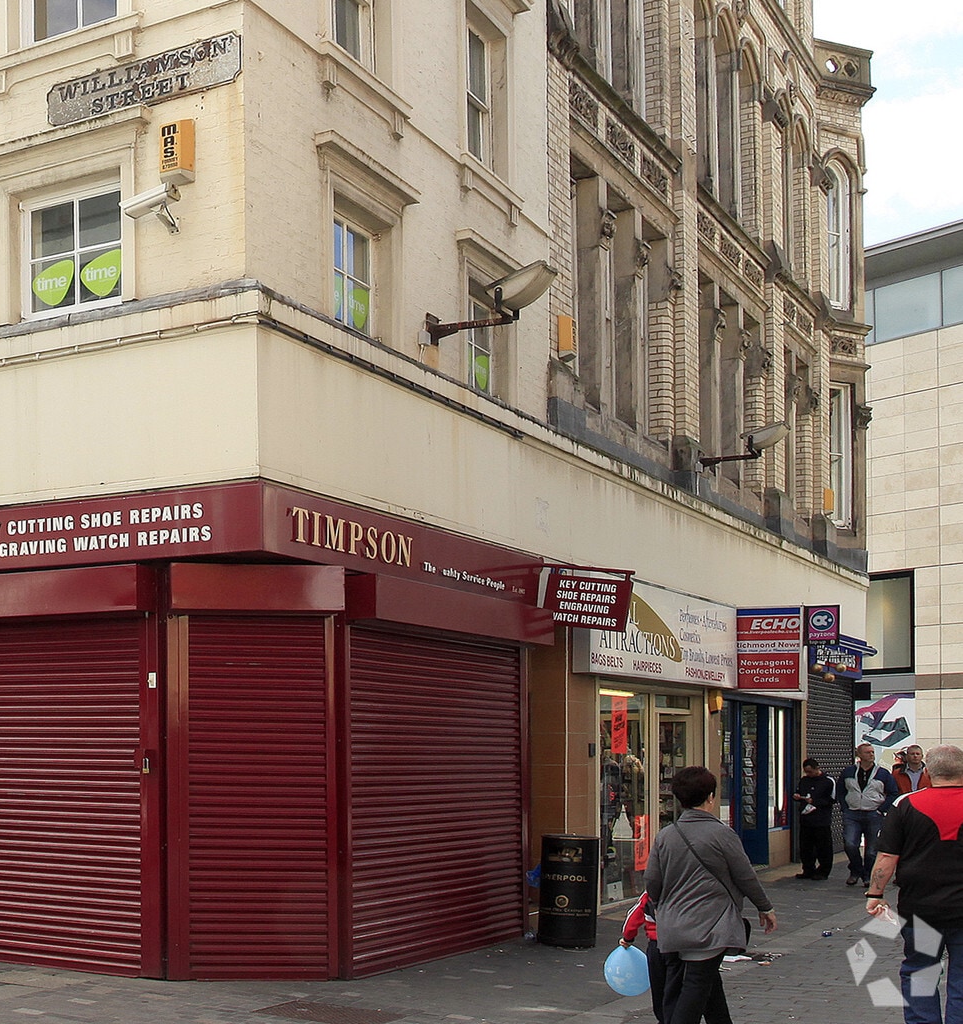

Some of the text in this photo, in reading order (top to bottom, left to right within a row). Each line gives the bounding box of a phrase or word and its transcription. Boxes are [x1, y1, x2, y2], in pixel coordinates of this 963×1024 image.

[57, 36, 234, 102] WILLIAMSON
[91, 72, 190, 114] STREET
[85, 265, 117, 281] time
[36, 275, 67, 291] time
[7, 514, 75, 537] CUTTING
[80, 511, 122, 529] SHOE
[129, 502, 204, 525] REPAIRS
[73, 532, 130, 552] WATCH
[137, 525, 212, 547] REPAIRS
[291, 506, 414, 568] TIMPSON
[423, 561, 437, 574] The
[462, 571, 485, 586] Service
[486, 577, 505, 591] People
[559, 579, 617, 593] KEY CUTTING
[556, 590, 617, 604] SHOE REPAIRS
[559, 600, 610, 614] ENGRAVING
[580, 615, 617, 627] REPAIRS
[750, 618, 800, 630] ECHO
[599, 629, 676, 659] ATTRACTIONS
[591, 652, 624, 668] BAGS BELTS
[632, 659, 663, 674] HAIRPIECES
[740, 659, 794, 667] Newsagents
[738, 667, 796, 675] Confectioner
